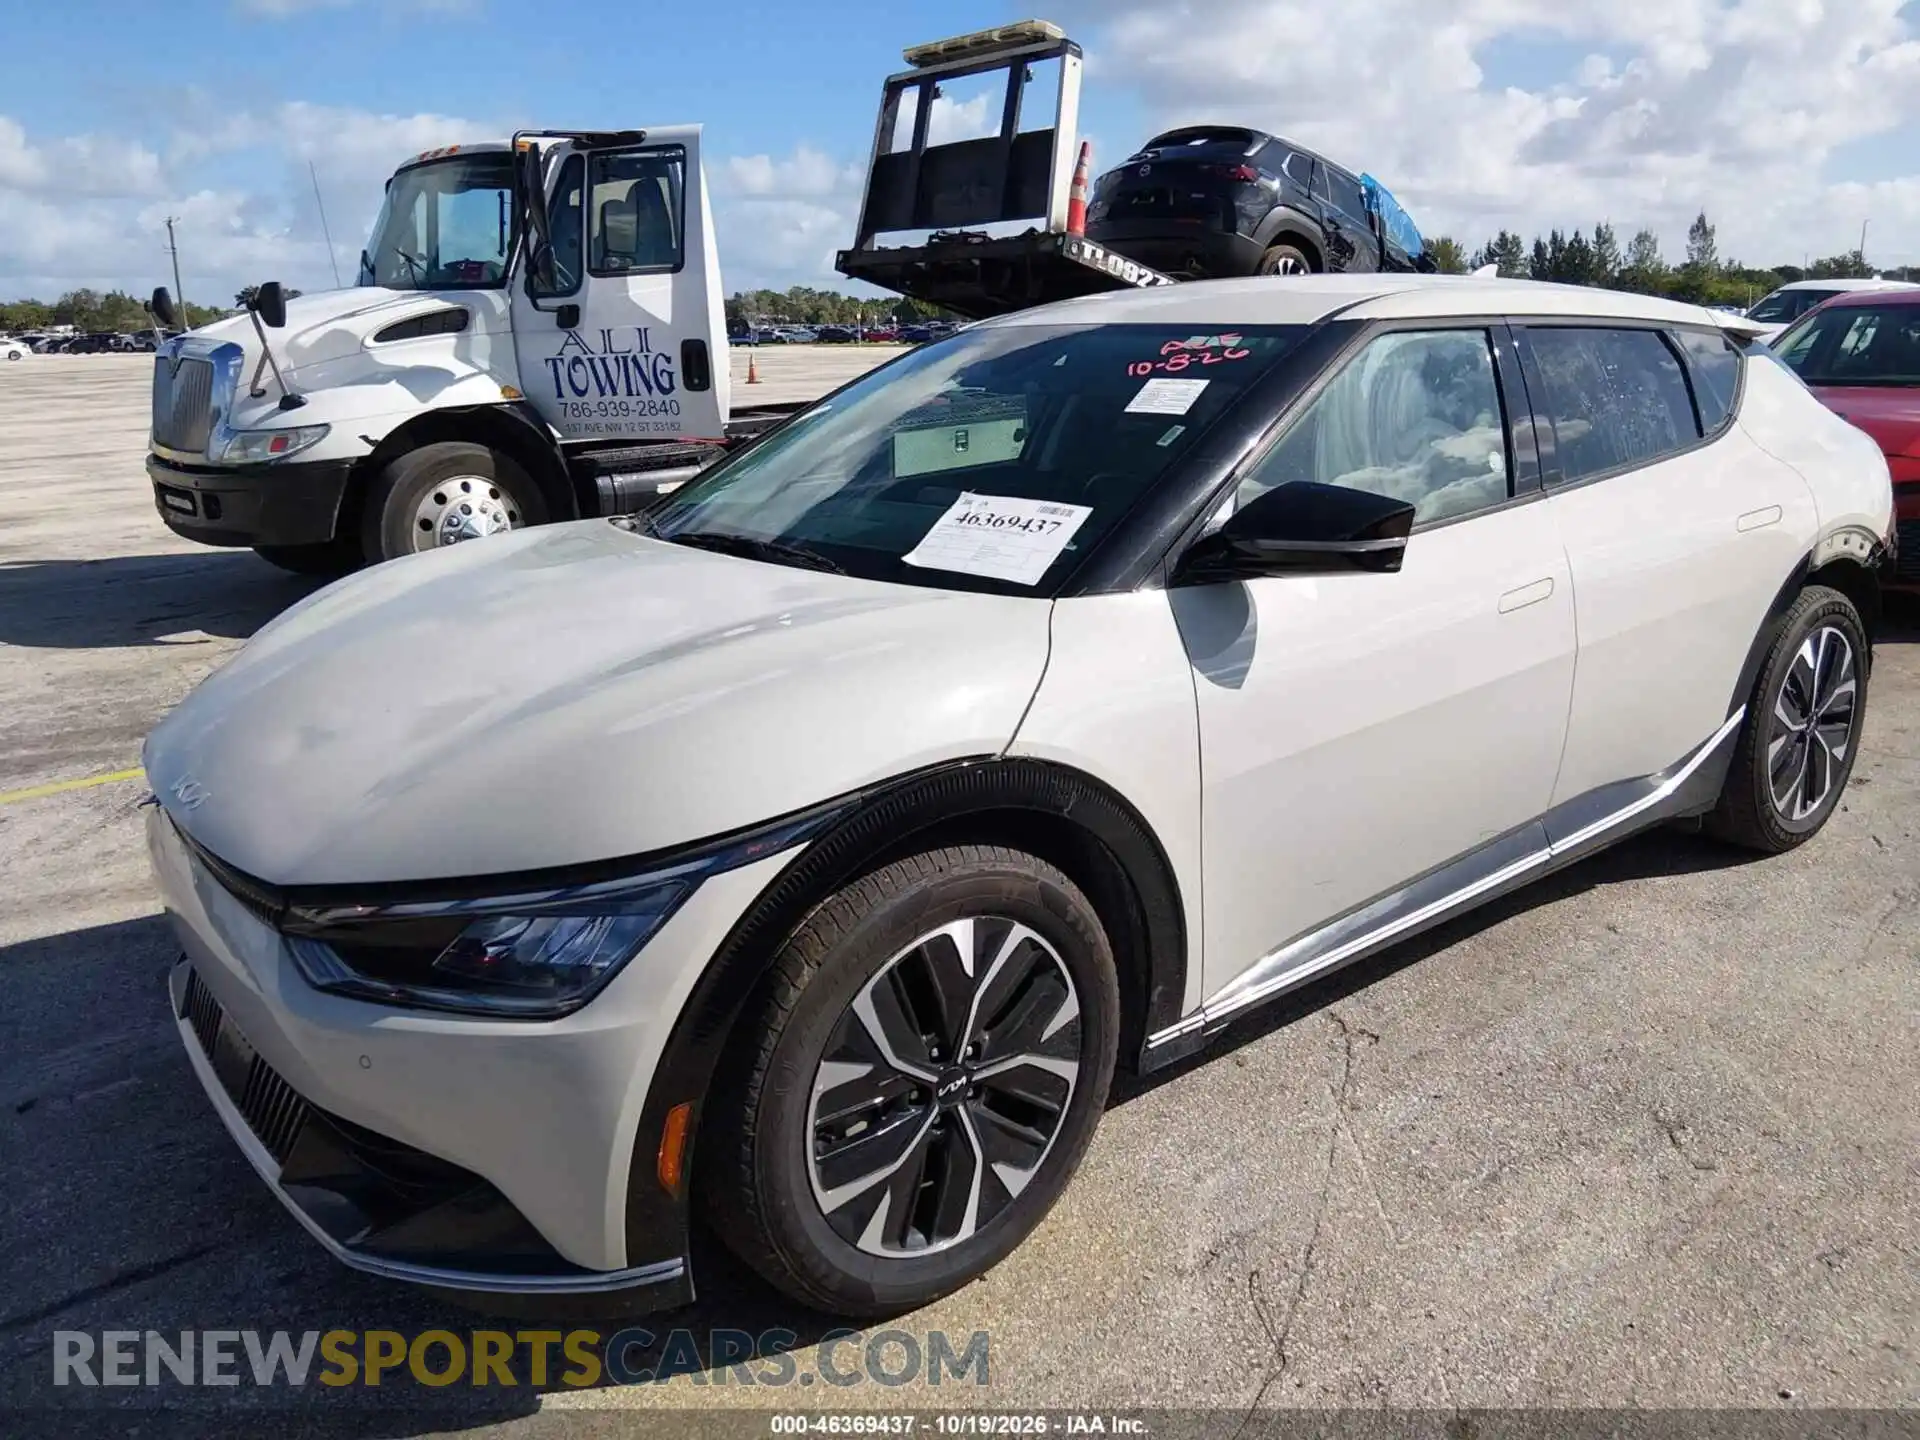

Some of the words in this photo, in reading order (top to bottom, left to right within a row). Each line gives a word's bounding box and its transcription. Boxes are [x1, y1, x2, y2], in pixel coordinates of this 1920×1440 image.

[556, 327, 653, 355] ALI
[544, 352, 676, 398] TOWING
[558, 399, 681, 419] 786-939-2840
[584, 422, 603, 433] AVE
[605, 422, 622, 433] NW
[625, 421, 636, 432] 12
[638, 421, 651, 432] ST
[955, 510, 1063, 536] 46369437
